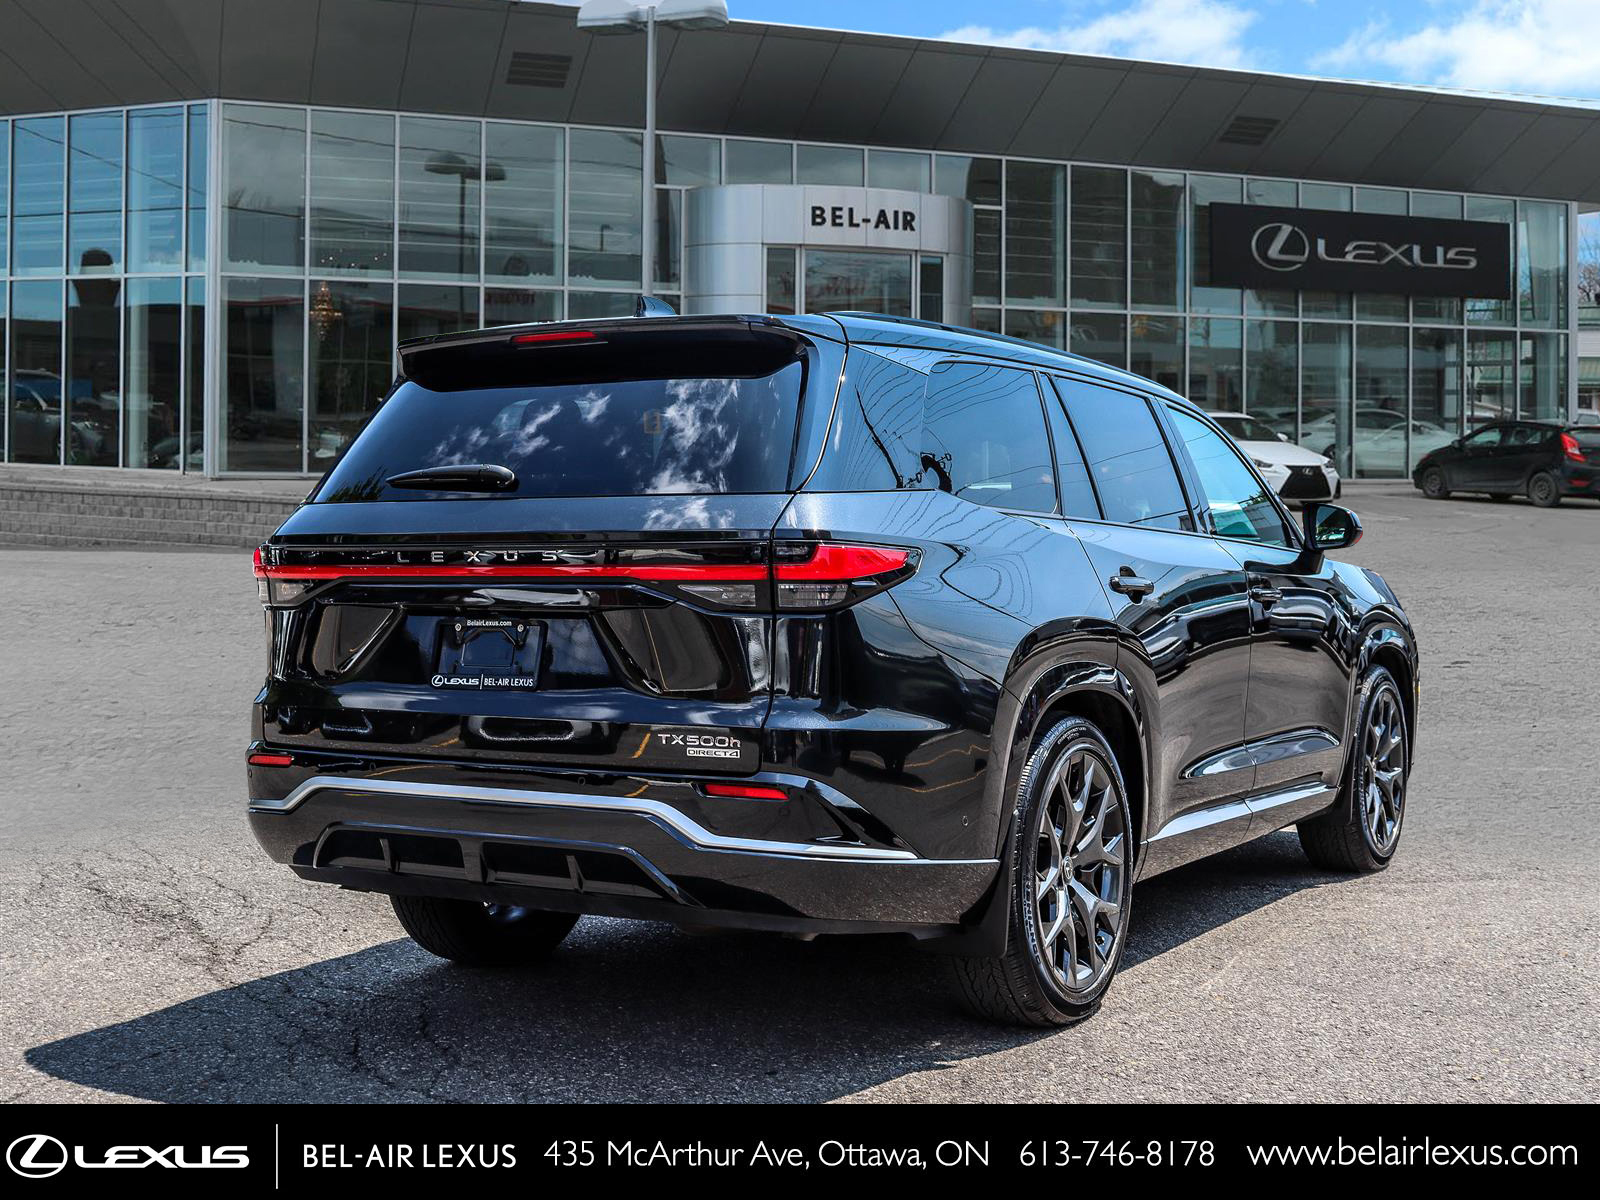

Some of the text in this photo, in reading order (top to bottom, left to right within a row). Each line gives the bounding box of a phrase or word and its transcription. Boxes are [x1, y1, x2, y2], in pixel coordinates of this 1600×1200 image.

[811, 206, 916, 231] BEL-AIR
[1317, 238, 1477, 269] LEXUS
[397, 551, 561, 563] LEXUS
[466, 619, 512, 627] BelairLexus.com
[444, 677, 479, 685] LEXUS
[511, 678, 533, 687] LEXUS
[657, 734, 741, 748] TX500h
[687, 748, 740, 758] DIRECT4
